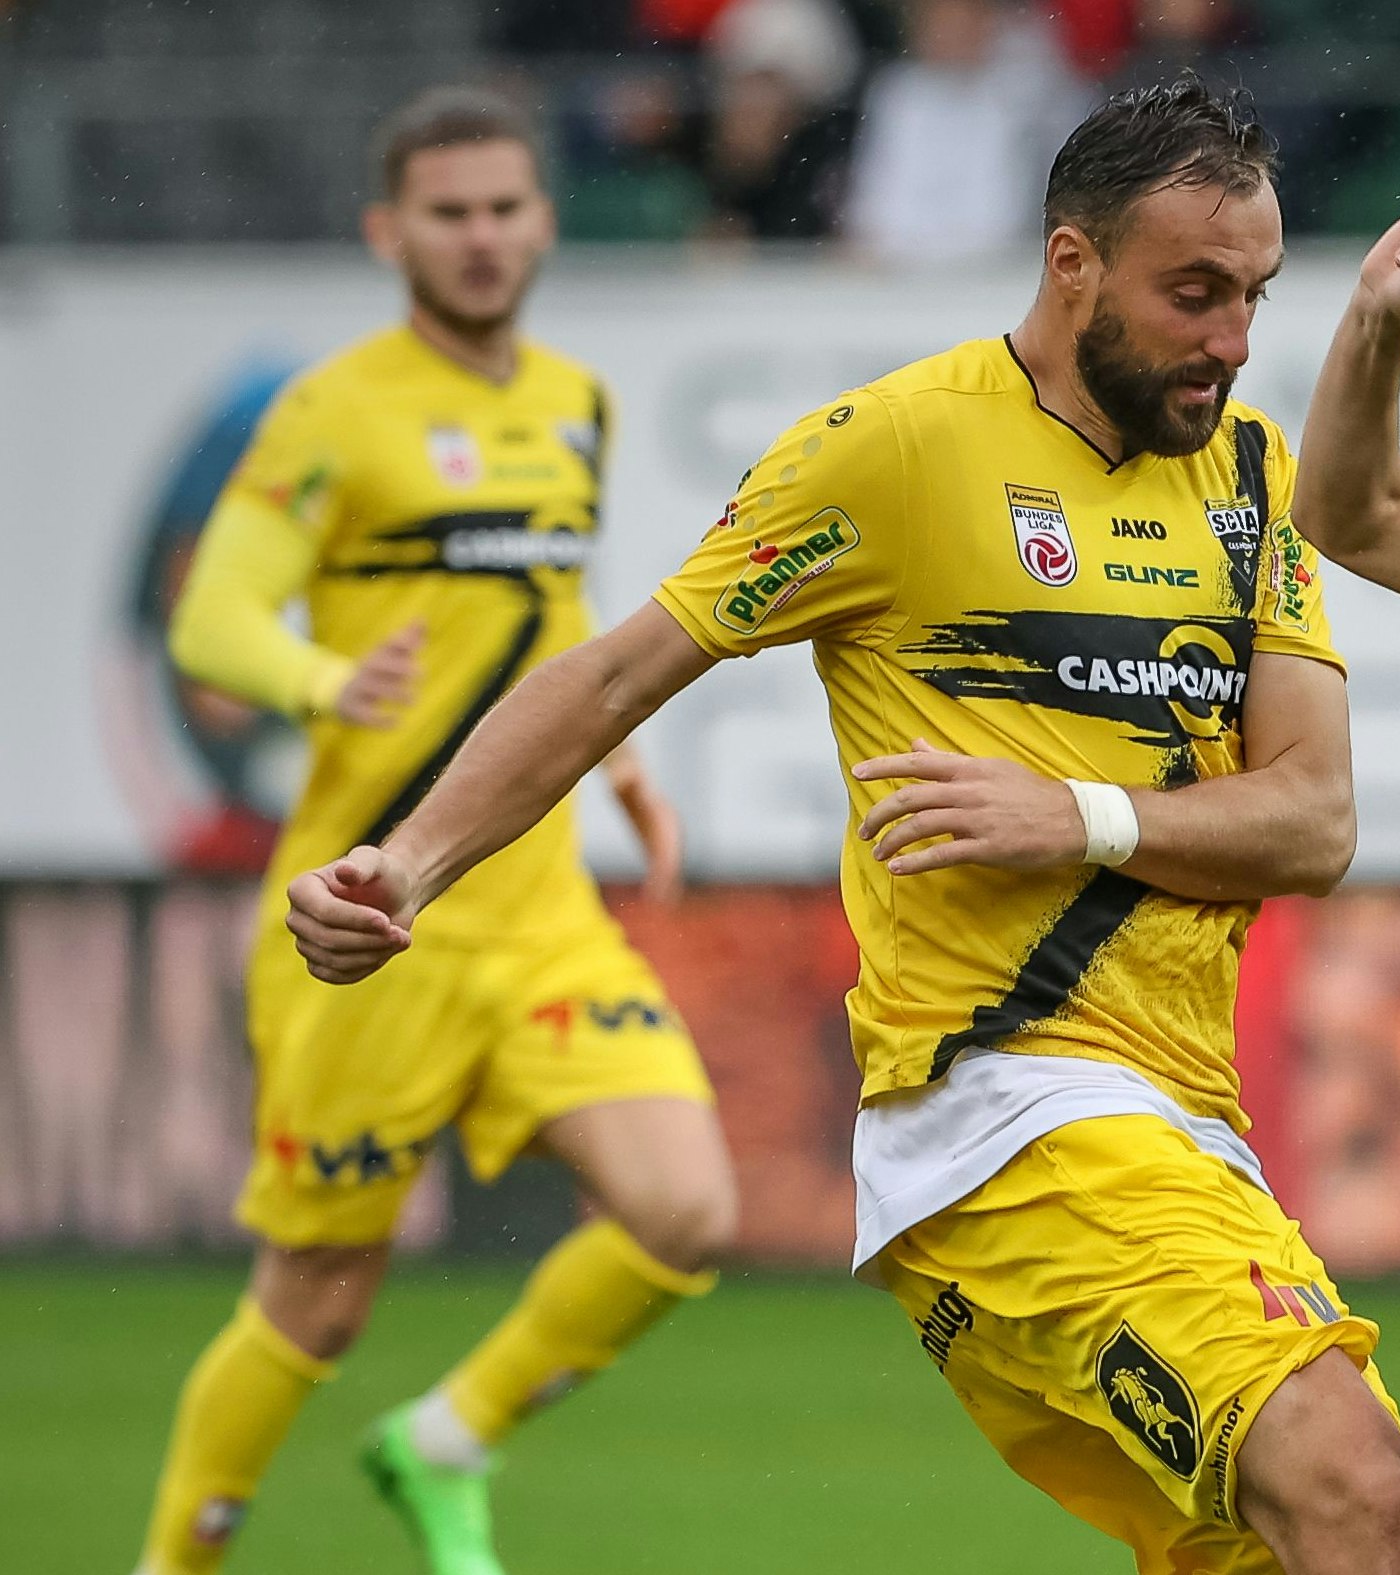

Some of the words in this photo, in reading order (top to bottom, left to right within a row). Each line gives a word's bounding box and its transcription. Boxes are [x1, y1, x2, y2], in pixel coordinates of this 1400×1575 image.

[1011, 491, 1058, 507] ADMIRAL
[1014, 508, 1063, 524] BUNDES
[1027, 518, 1057, 532] LIGA
[1111, 516, 1168, 541] JAKO
[725, 520, 846, 625] pfanner
[1103, 562, 1201, 589] GUNZ
[1057, 654, 1248, 705] CASHPOINT
